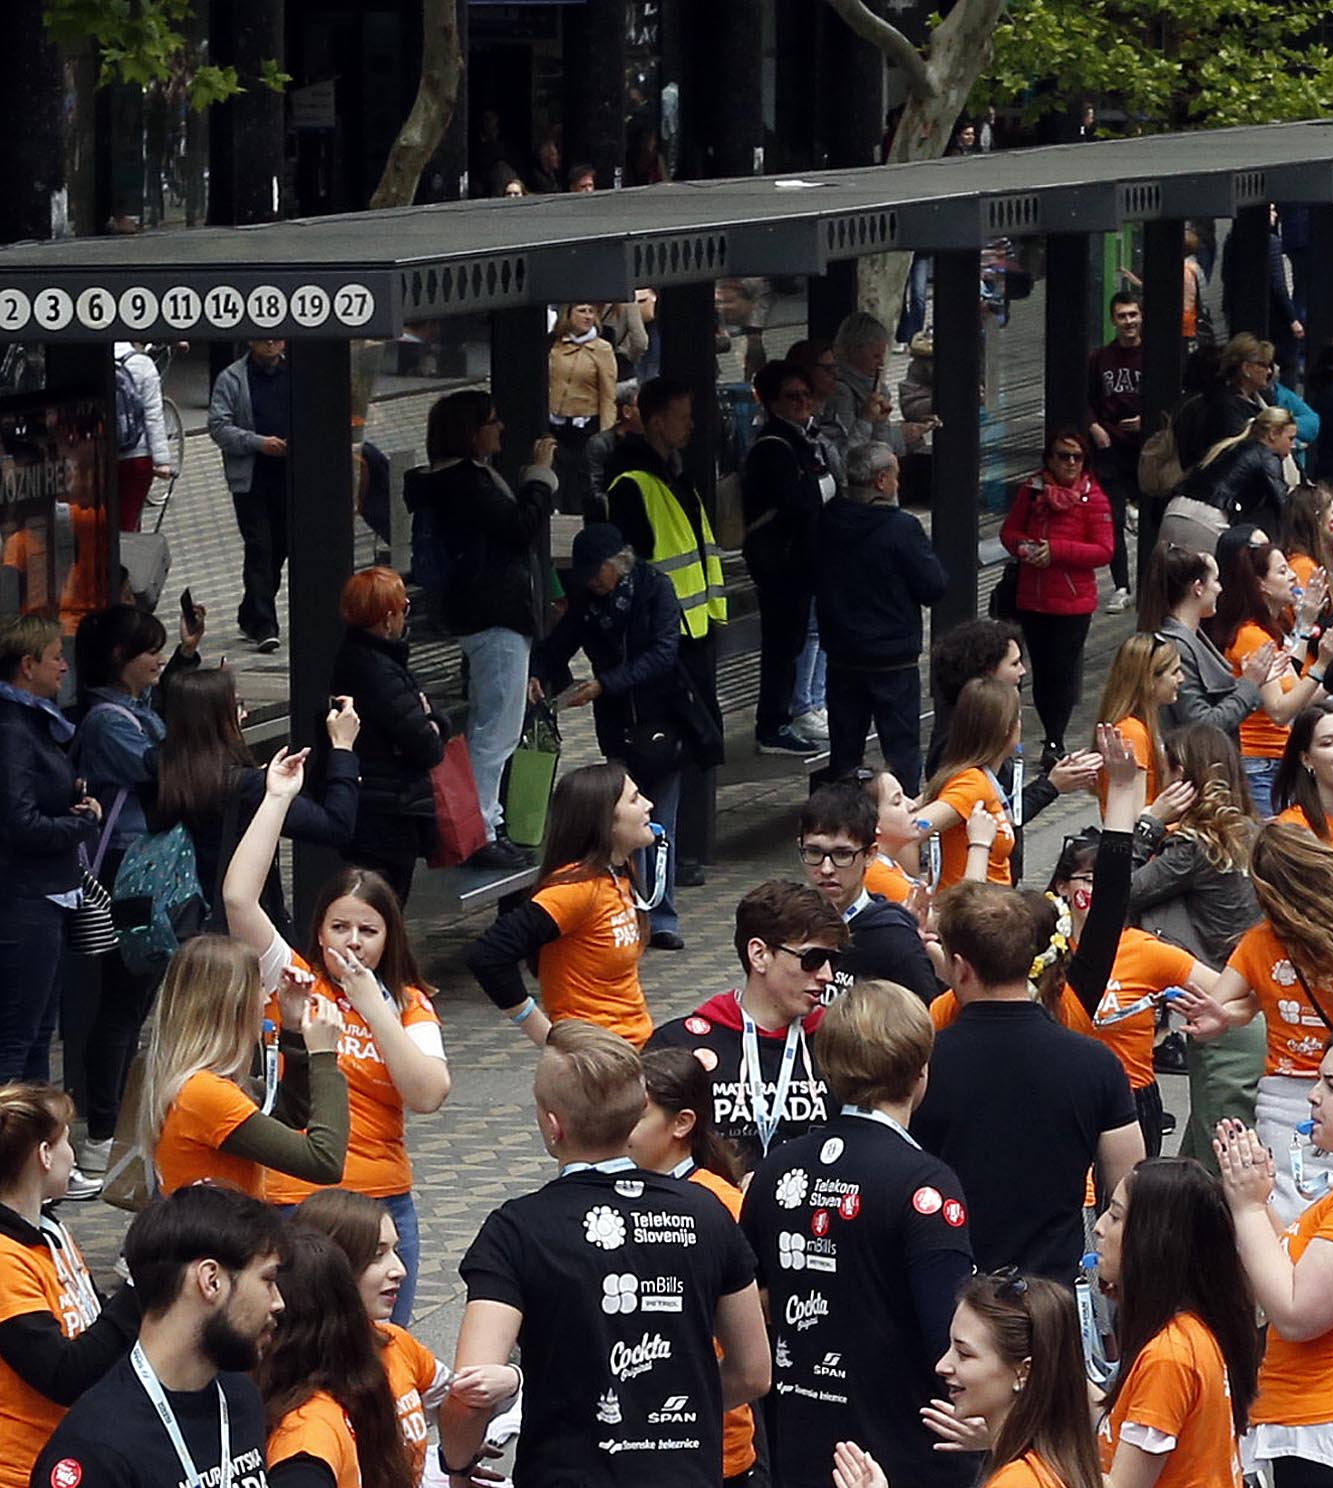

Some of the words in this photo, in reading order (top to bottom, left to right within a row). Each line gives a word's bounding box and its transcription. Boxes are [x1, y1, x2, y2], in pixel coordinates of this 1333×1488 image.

[6, 298, 18, 321] 2
[46, 296, 60, 322] 3
[88, 294, 103, 321] 6
[131, 294, 145, 320] 9
[170, 294, 193, 320] 11
[211, 293, 239, 319] 14
[255, 295, 279, 318] 18
[298, 294, 323, 317] 19
[340, 293, 367, 317] 27
[814, 1178, 860, 1195] Telekom
[810, 1192, 843, 1208] Sloven
[630, 1212, 695, 1230] Telekom
[633, 1227, 697, 1247] Slovenije
[806, 1238, 837, 1255] mBills
[641, 1275, 684, 1294] mBills
[786, 1289, 829, 1325] Cockta
[610, 1332, 671, 1377] Cockta
